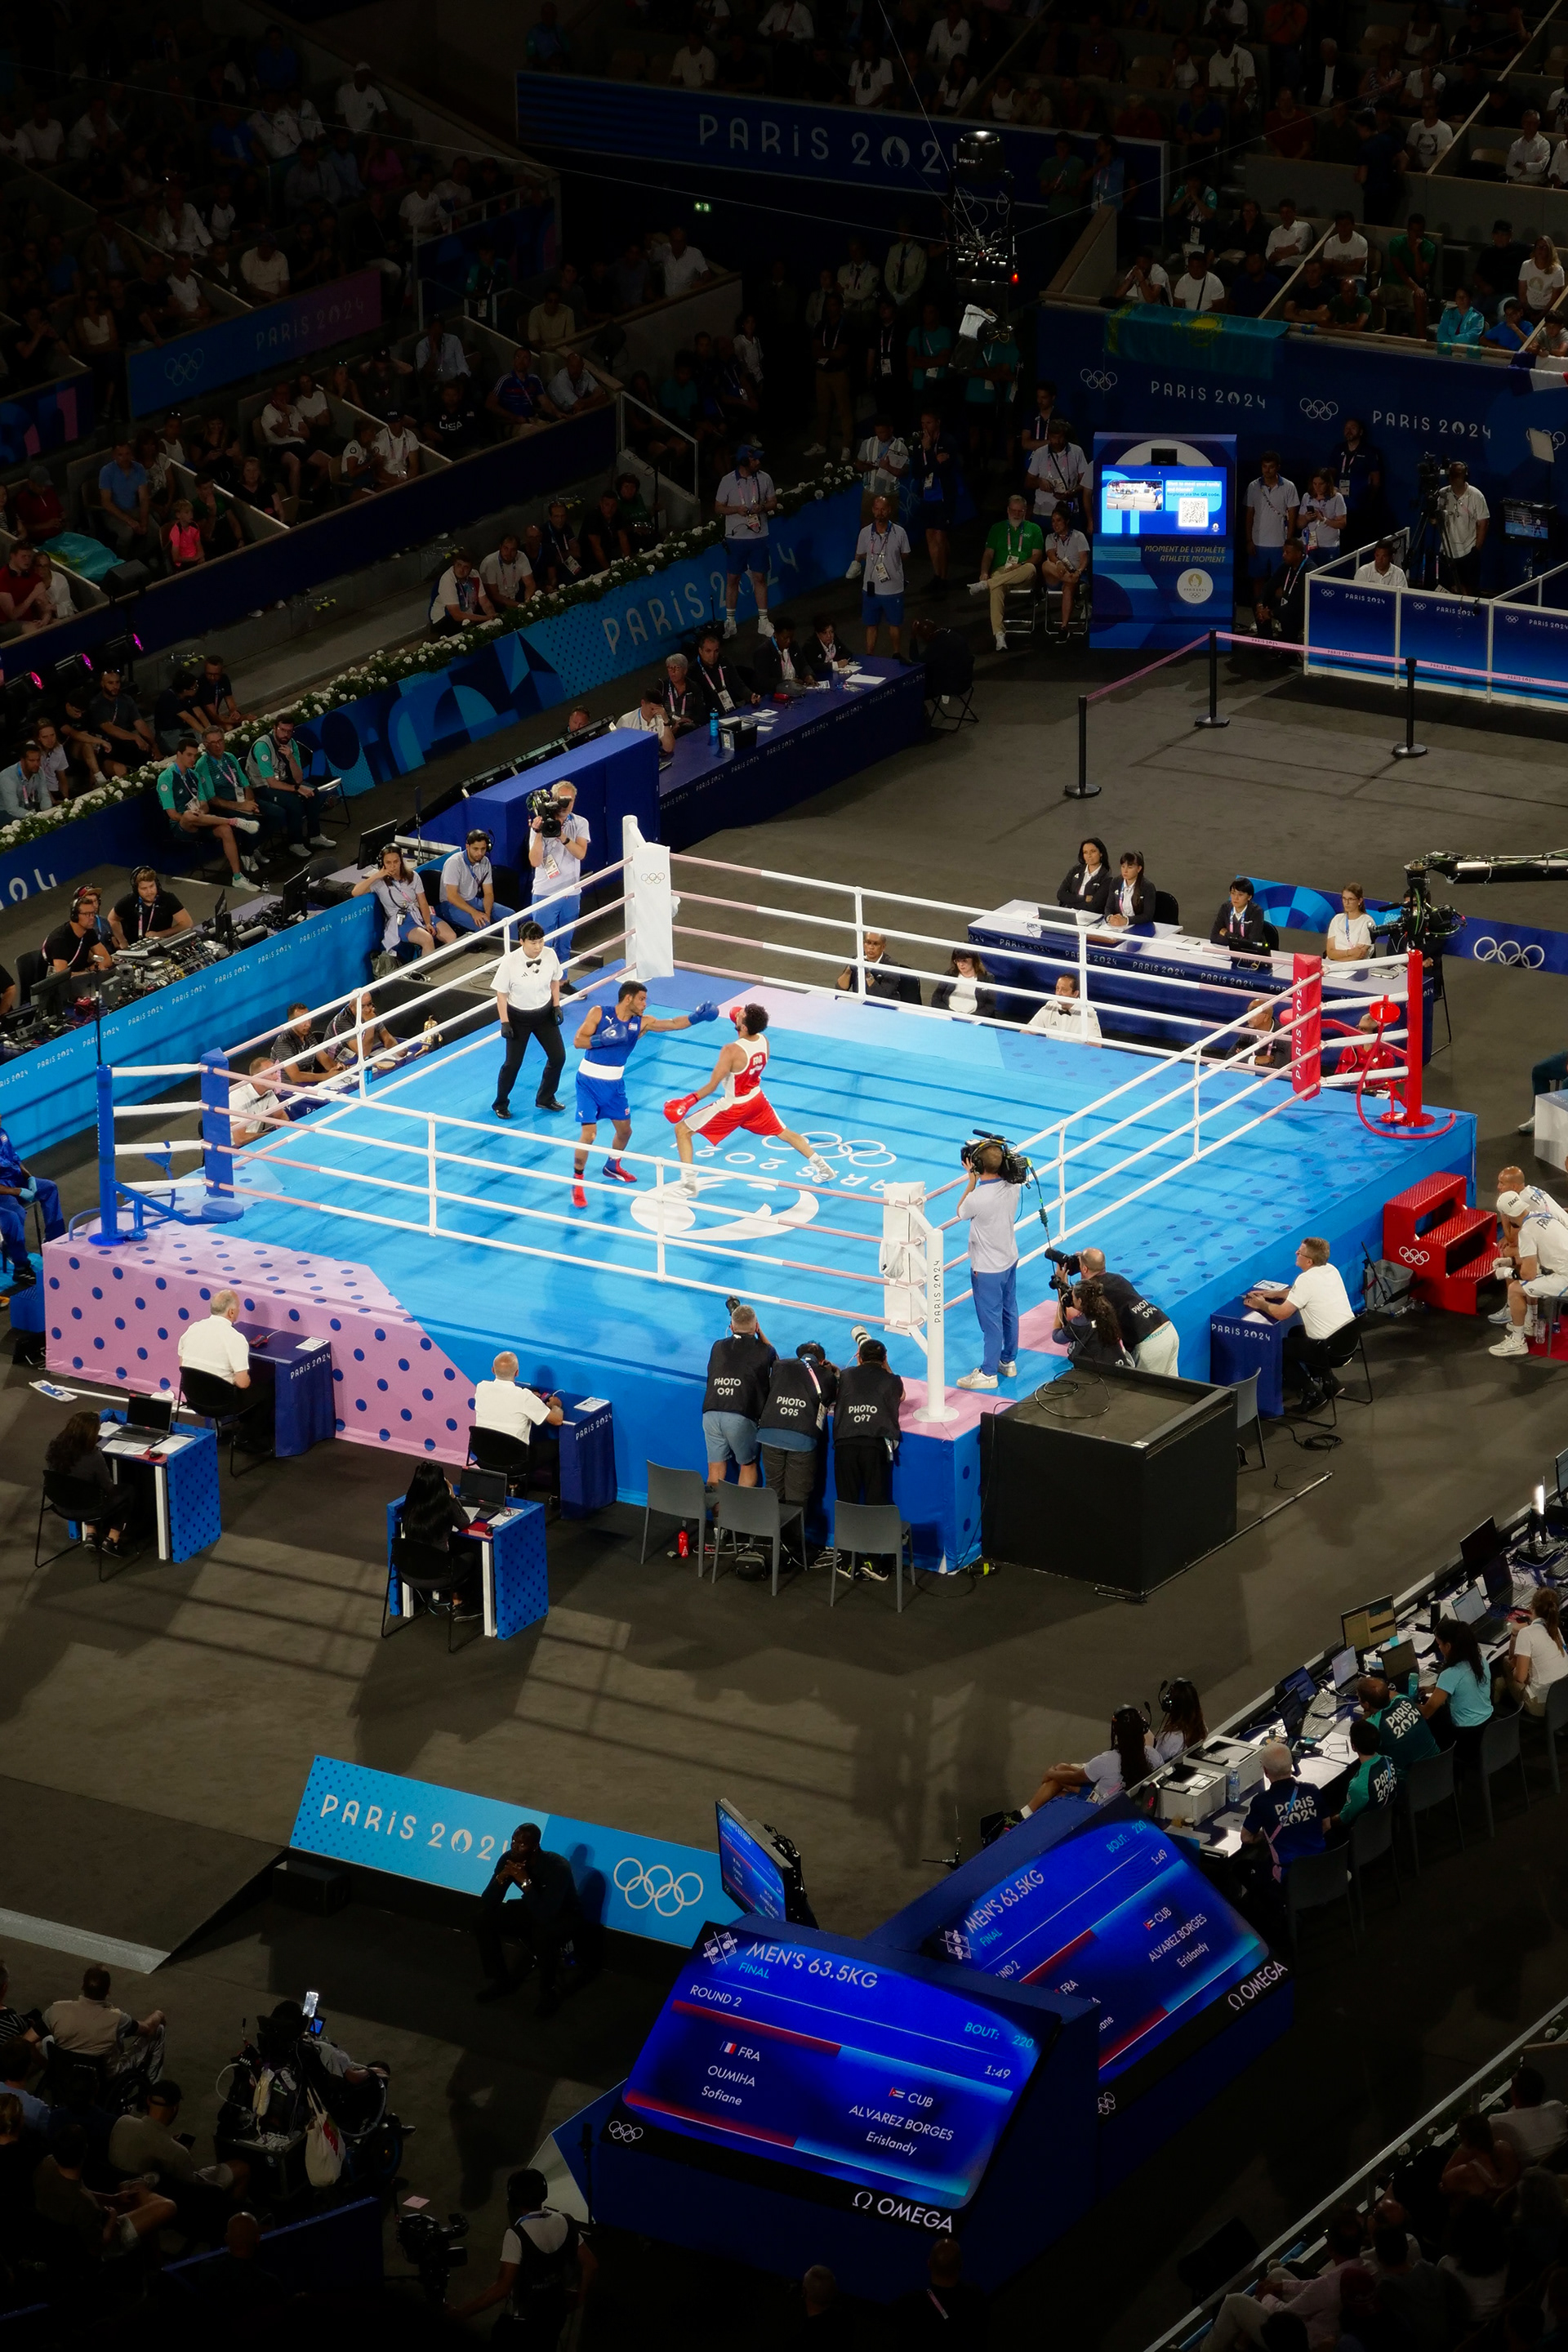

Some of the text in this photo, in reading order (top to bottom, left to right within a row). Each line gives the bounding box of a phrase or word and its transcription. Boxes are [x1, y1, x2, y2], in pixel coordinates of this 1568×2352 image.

[699, 114, 957, 173] PARIS 202
[256, 297, 364, 351] PARIS 2024
[1151, 381, 1266, 408] PARIS 2024
[439, 420, 462, 431] USA
[1373, 410, 1491, 439] PARIS 2024
[1345, 593, 1365, 602] PARIS
[602, 581, 705, 655] PARIS
[1436, 606, 1476, 617] PARIS 2024
[1529, 618, 1568, 630] PARIS 2024
[869, 694, 883, 704] PARIS
[835, 710, 849, 722] PARIS
[801, 727, 816, 739] PARIS
[767, 745, 781, 756] PARIS
[731, 761, 746, 773] PARIS
[696, 779, 710, 791] PARIS
[660, 798, 675, 810] PARIS
[341, 904, 374, 924] PARIS 2024
[299, 924, 333, 944] PARIS 2024
[257, 944, 292, 964] PARIS 2024
[999, 938, 1027, 950] PARIS
[1029, 944, 1052, 954] 2024
[1094, 955, 1118, 966] 2024
[1132, 960, 1159, 973] PARIS
[1161, 965, 1186, 977] 2024
[1200, 972, 1227, 984] PARIS
[1230, 977, 1254, 989] 2024
[214, 964, 251, 985] PARIS 2024
[172, 984, 207, 1004] PARIS 2024
[127, 1004, 163, 1026] PARIS 2024
[102, 1026, 120, 1039] 2024
[37, 1048, 74, 1069] PARIS 2024
[11, 1070, 29, 1081] 2024
[933, 1260, 941, 1288] 2024
[1131, 1298, 1148, 1314] PHOT
[1143, 1307, 1158, 1319] 094
[1211, 1323, 1271, 1341] PARIS 2024
[290, 1352, 331, 1379] PARIS 2024
[714, 1377, 742, 1387] PHOTO
[717, 1387, 734, 1396] 091
[777, 1396, 807, 1409] PHOTO
[780, 1406, 799, 1417] 095
[849, 1405, 878, 1414] PHOTO
[576, 1413, 612, 1441] PARIS 2024
[853, 1414, 871, 1423] 097
[1385, 1700, 1412, 1729] PARIS
[1392, 1708, 1421, 1740] 2024
[319, 1793, 417, 1840] PARIS
[1106, 1820, 1147, 1854] BOUT: 220
[1151, 1848, 1168, 1866] 1:49
[964, 1869, 1045, 1934] MEN'S 63.5KG
[1154, 1906, 1173, 1923] CUB
[979, 1928, 1003, 1947] FINAL
[1148, 1913, 1208, 1962] ALVAREZ BORGES
[1176, 1940, 1210, 1968] Erislandy
[738, 1962, 770, 1980] FINAL
[746, 1942, 878, 1989] MEN'S 63.5KG
[1011, 1960, 1021, 1970] 2
[1060, 1979, 1079, 1995] FRA
[1240, 1960, 1289, 2001] OMEGA
[690, 1984, 742, 2008] ROUND 2
[964, 2022, 1035, 2048] BOUT: 220
[737, 2046, 760, 2062] FRA
[707, 2065, 755, 2087] OUMIHA
[984, 2065, 1011, 2080] 1:49
[702, 2085, 742, 2106] Sofiane
[907, 2092, 933, 2109] CUB
[849, 2105, 955, 2142] ALVAREZ BORGES
[866, 2131, 917, 2156] Erislandy
[876, 2197, 954, 2233] OMEGA
